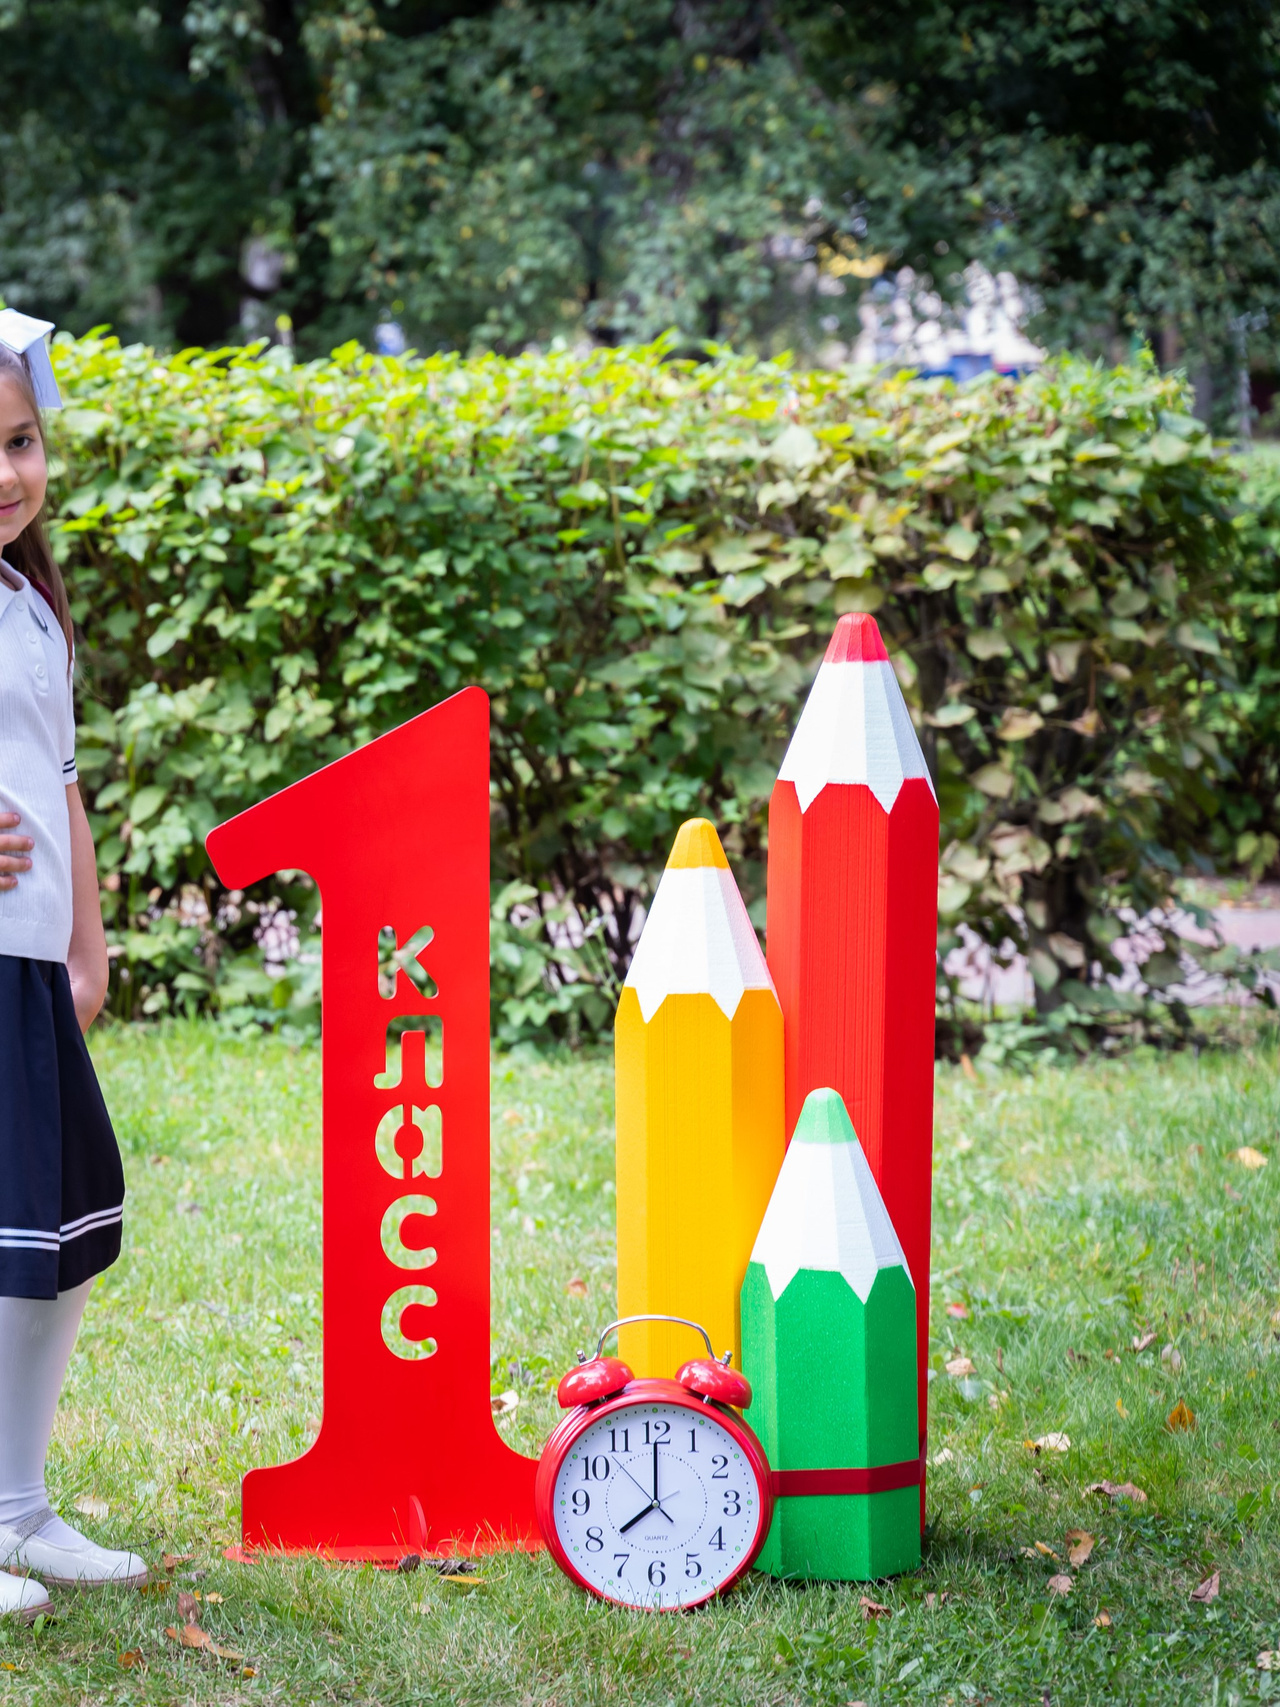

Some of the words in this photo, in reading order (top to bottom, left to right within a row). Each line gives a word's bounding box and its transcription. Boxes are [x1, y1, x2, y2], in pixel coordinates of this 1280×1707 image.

[608, 1428, 632, 1453] 11
[642, 1420, 671, 1445] 12
[688, 1428, 700, 1453] 1
[581, 1455, 610, 1481] 10
[712, 1455, 729, 1480] 2
[572, 1489, 590, 1516] 9
[723, 1490, 741, 1516] 3
[585, 1526, 604, 1552] 8
[708, 1526, 726, 1551] 4
[614, 1554, 630, 1578] 7
[647, 1561, 667, 1587] 6
[685, 1553, 702, 1578] 5
